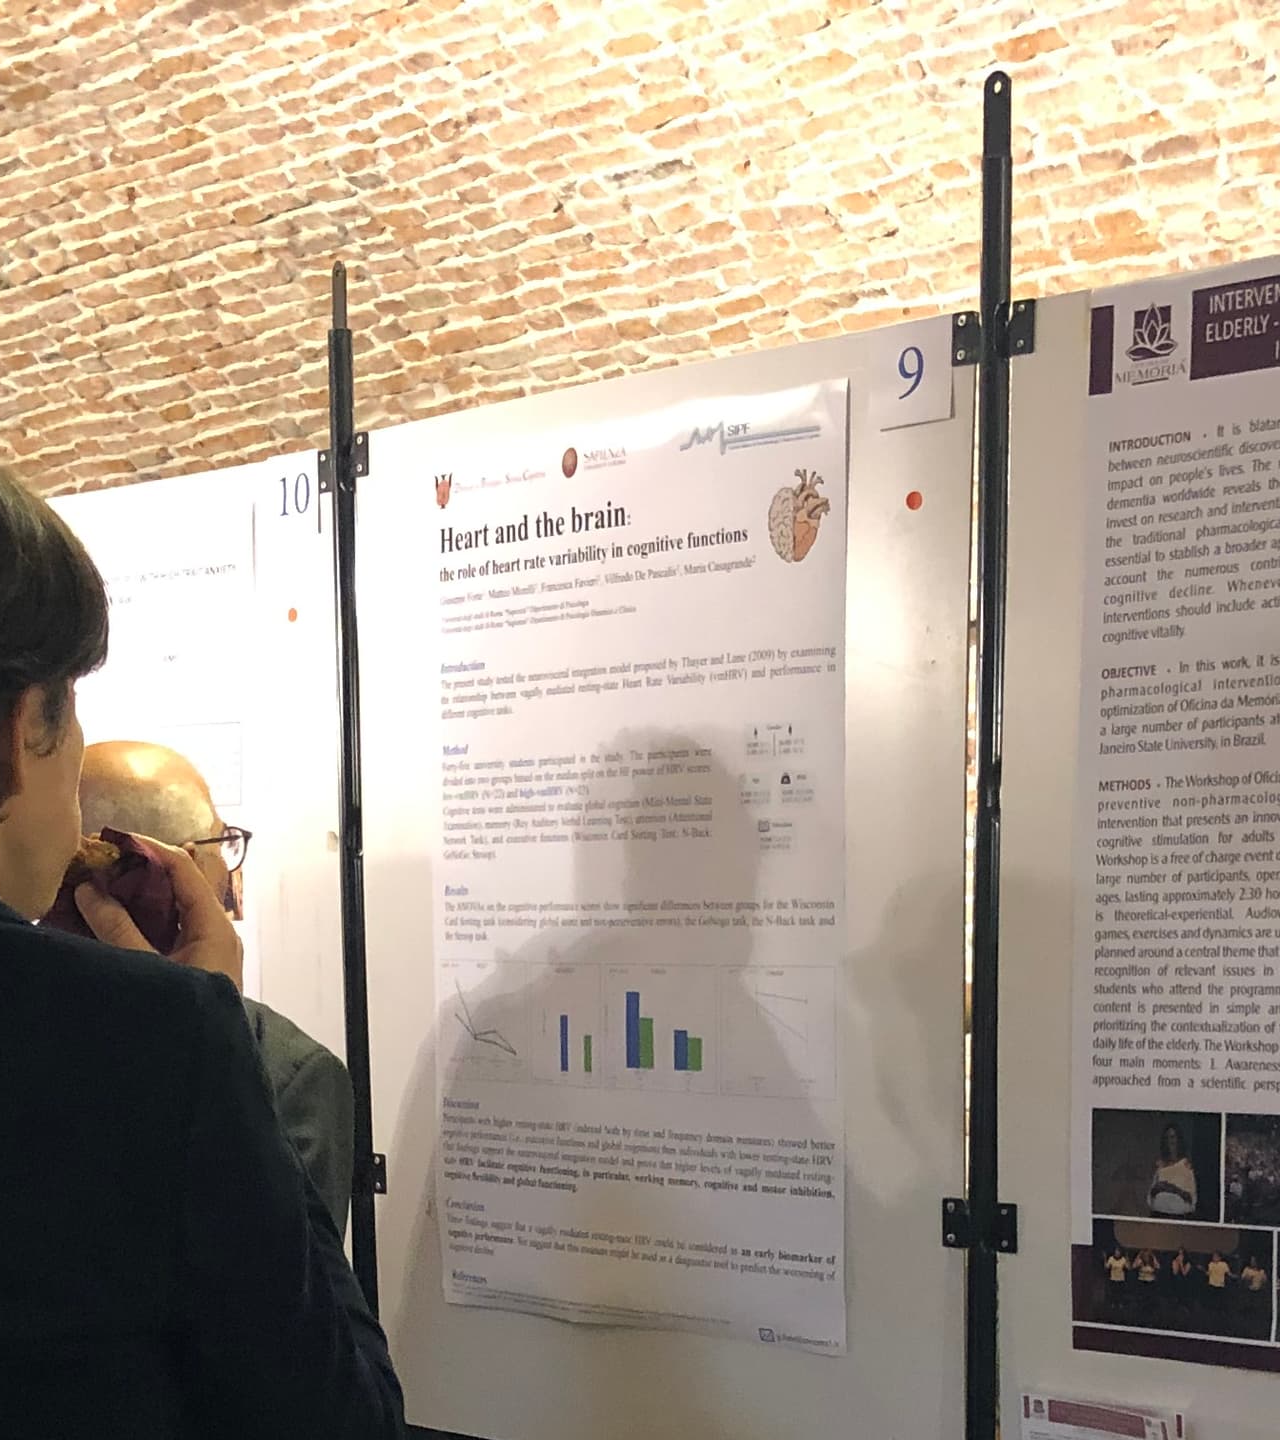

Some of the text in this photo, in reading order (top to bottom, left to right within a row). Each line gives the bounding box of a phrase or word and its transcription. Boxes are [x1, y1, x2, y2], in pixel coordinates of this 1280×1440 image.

[1205, 313, 1270, 343] ELDERLY
[897, 345, 925, 400] 9
[1109, 431, 1191, 452] INTRODUCTION
[1217, 425, 1224, 437] It
[1232, 424, 1241, 435] is
[1108, 458, 1151, 472] between
[1157, 444, 1232, 466] neuroscientific
[1108, 476, 1143, 492] impact
[1150, 475, 1162, 486] on
[1252, 458, 1270, 472] The
[279, 472, 310, 517] 10
[1107, 494, 1156, 510] dementia
[1163, 487, 1215, 504] worldwide
[1223, 480, 1261, 496] reveals
[440, 501, 631, 553] Heart and the brain:
[1106, 516, 1137, 529] invest
[1141, 514, 1154, 525] on
[1159, 508, 1203, 523] research
[1208, 504, 1227, 517] and
[1106, 536, 1122, 548] the
[1132, 528, 1186, 545] traditional
[440, 527, 748, 582] the role of heart rate variability in cognitive functions
[1106, 552, 1151, 568] essential
[1156, 550, 1165, 562] to
[1170, 544, 1209, 560] stablish
[1214, 546, 1220, 555] a
[1225, 540, 1266, 554] broader
[1104, 572, 1146, 586] account
[1157, 568, 1173, 580] the
[1185, 562, 1239, 578] numerous
[1104, 589, 1157, 606] cognitive
[1104, 608, 1170, 624] interventions
[1176, 602, 1211, 618] should
[1216, 598, 1255, 613] include
[1102, 628, 1149, 643] cognitive
[1102, 664, 1156, 680] OBJECTIVE
[1179, 661, 1190, 673] In
[1196, 658, 1215, 672] this
[1257, 654, 1264, 667] it
[1271, 653, 1280, 665] is
[1099, 779, 1150, 792] METHODS
